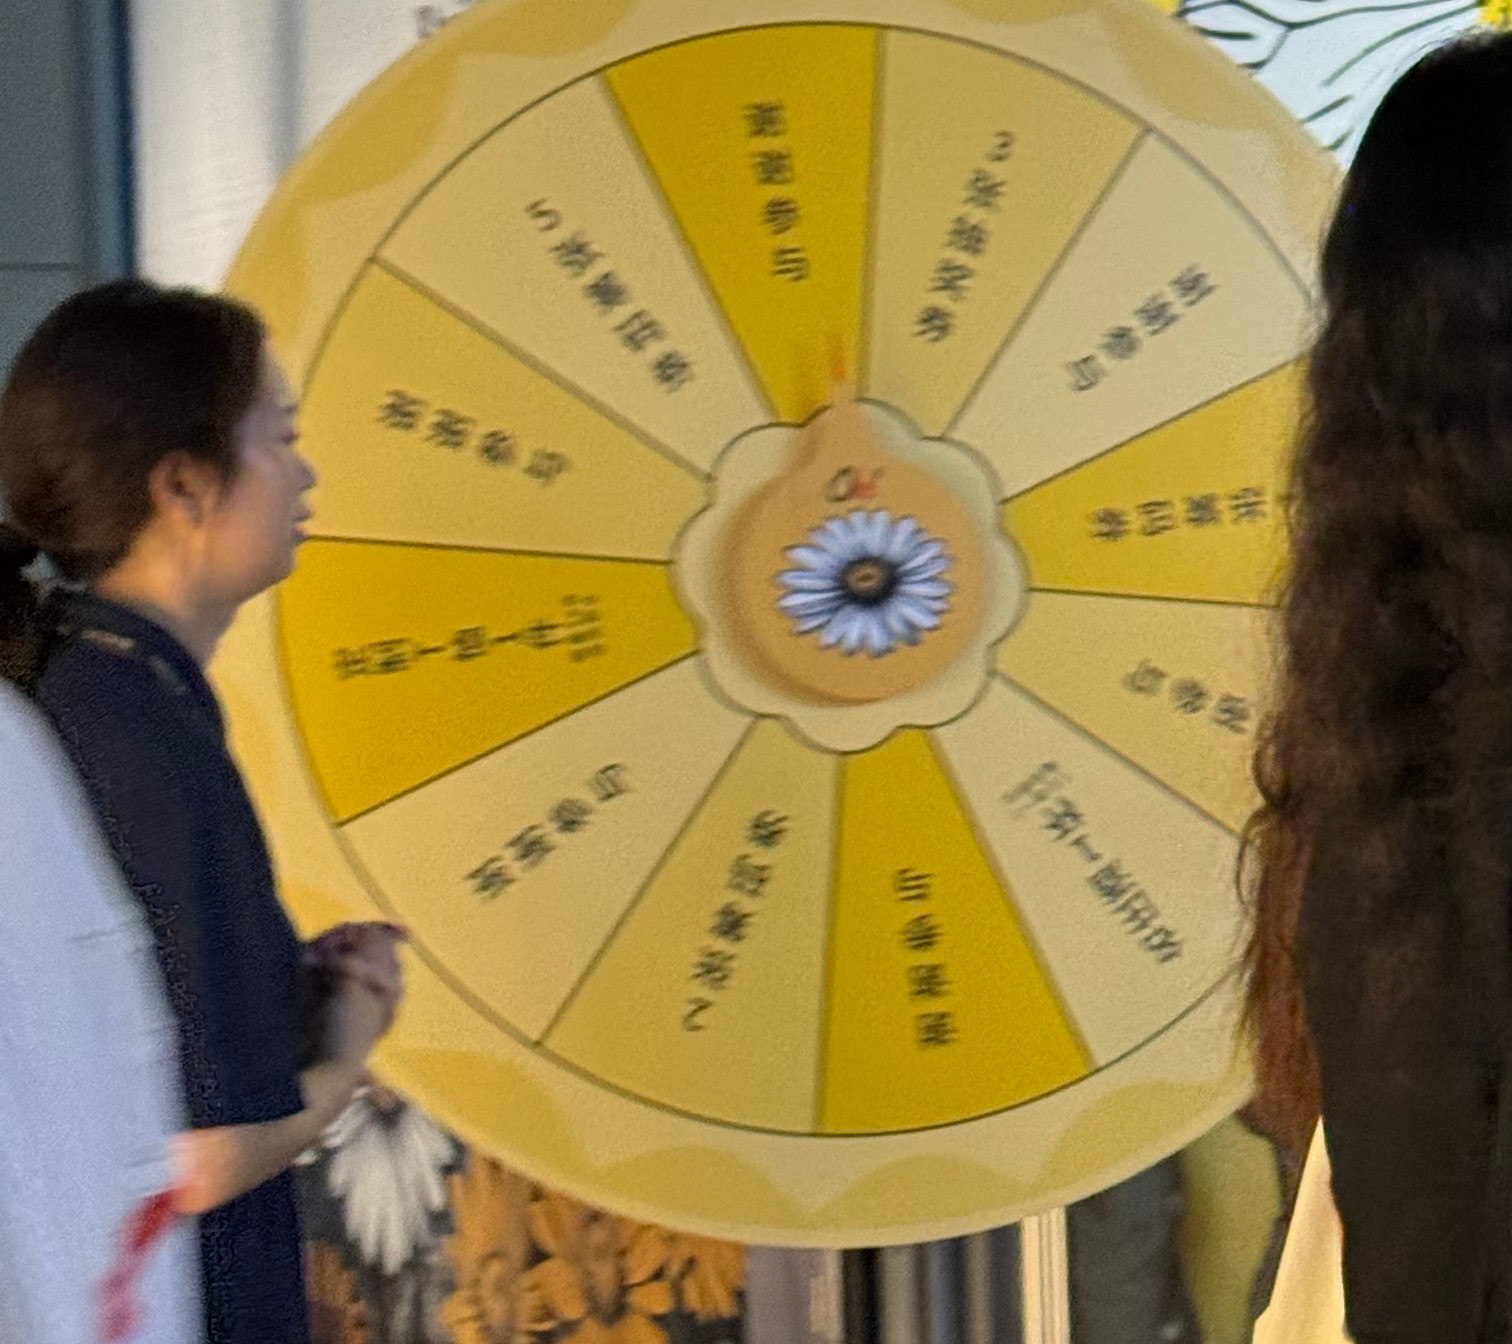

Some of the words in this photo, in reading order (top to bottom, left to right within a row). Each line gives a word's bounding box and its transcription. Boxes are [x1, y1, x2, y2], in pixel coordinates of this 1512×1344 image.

[1066, 265, 1218, 392] 谢谢参与
[1088, 487, 1267, 542] 张筹码券
[1122, 660, 1250, 733] 谢参与
[464, 763, 631, 901] 谢谢参与
